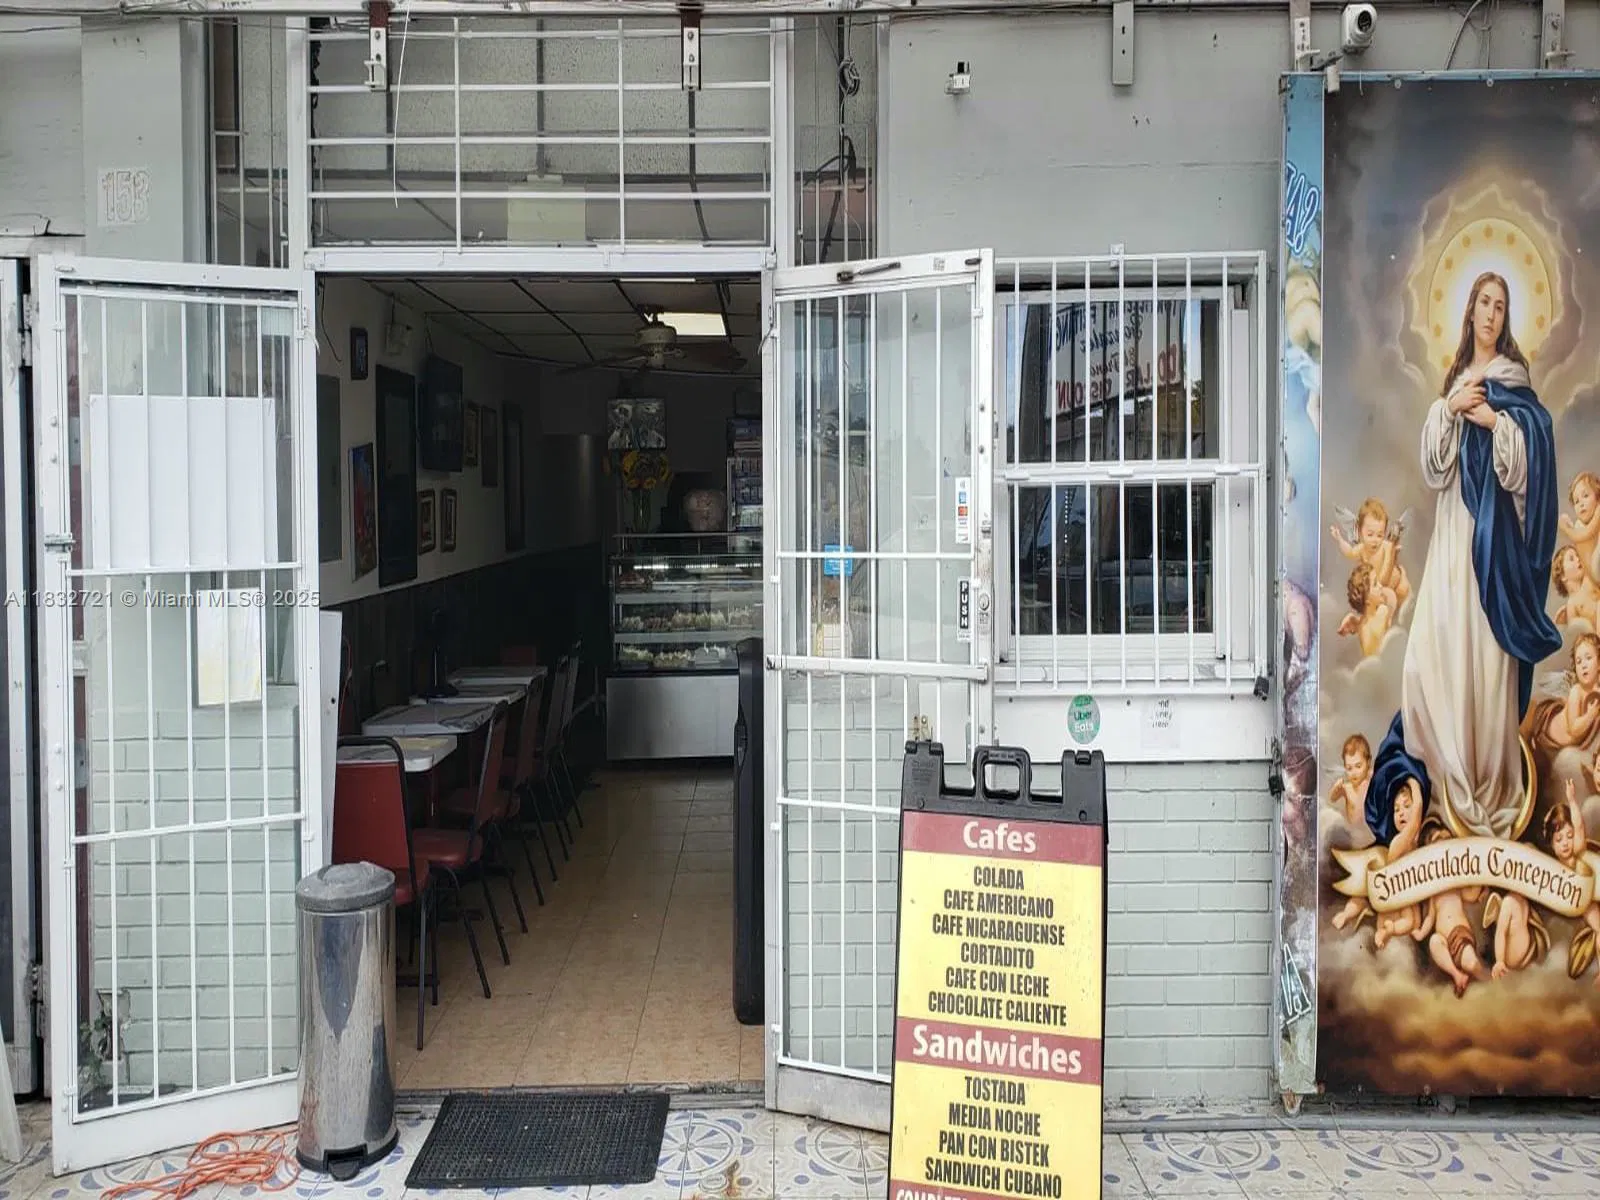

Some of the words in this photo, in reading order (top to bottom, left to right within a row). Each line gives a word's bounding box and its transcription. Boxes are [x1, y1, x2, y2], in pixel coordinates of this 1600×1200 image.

[959, 581, 969, 628] PUSH
[963, 820, 1037, 854] Cafes
[973, 866, 1025, 890] COLADA
[1373, 847, 1481, 902] Inmaculada
[1487, 846, 1582, 909] Concepción
[943, 889, 974, 912] CAFE
[977, 892, 1054, 919] AMERICANO
[932, 913, 963, 936] CAFE
[966, 917, 1065, 946] NICARAGUENSE
[961, 942, 1035, 969] CORTADITO
[945, 967, 976, 990] CAFE
[979, 969, 1007, 993] CON
[1010, 974, 1049, 998] LECHE
[928, 991, 1003, 1020] CHOCOLATE
[1006, 999, 1067, 1026] CALIENTE
[912, 1024, 1082, 1075] Sandwiches
[964, 1076, 1026, 1105] TOSTADA
[948, 1103, 992, 1130] MEDIA
[995, 1110, 1041, 1137] NOCHE
[939, 1130, 965, 1156] PAN
[968, 1135, 997, 1160] CON
[1000, 1139, 1050, 1168] BISTEK
[925, 1157, 1001, 1191] SANDWICH
[1004, 1167, 1062, 1200] CUBANO
